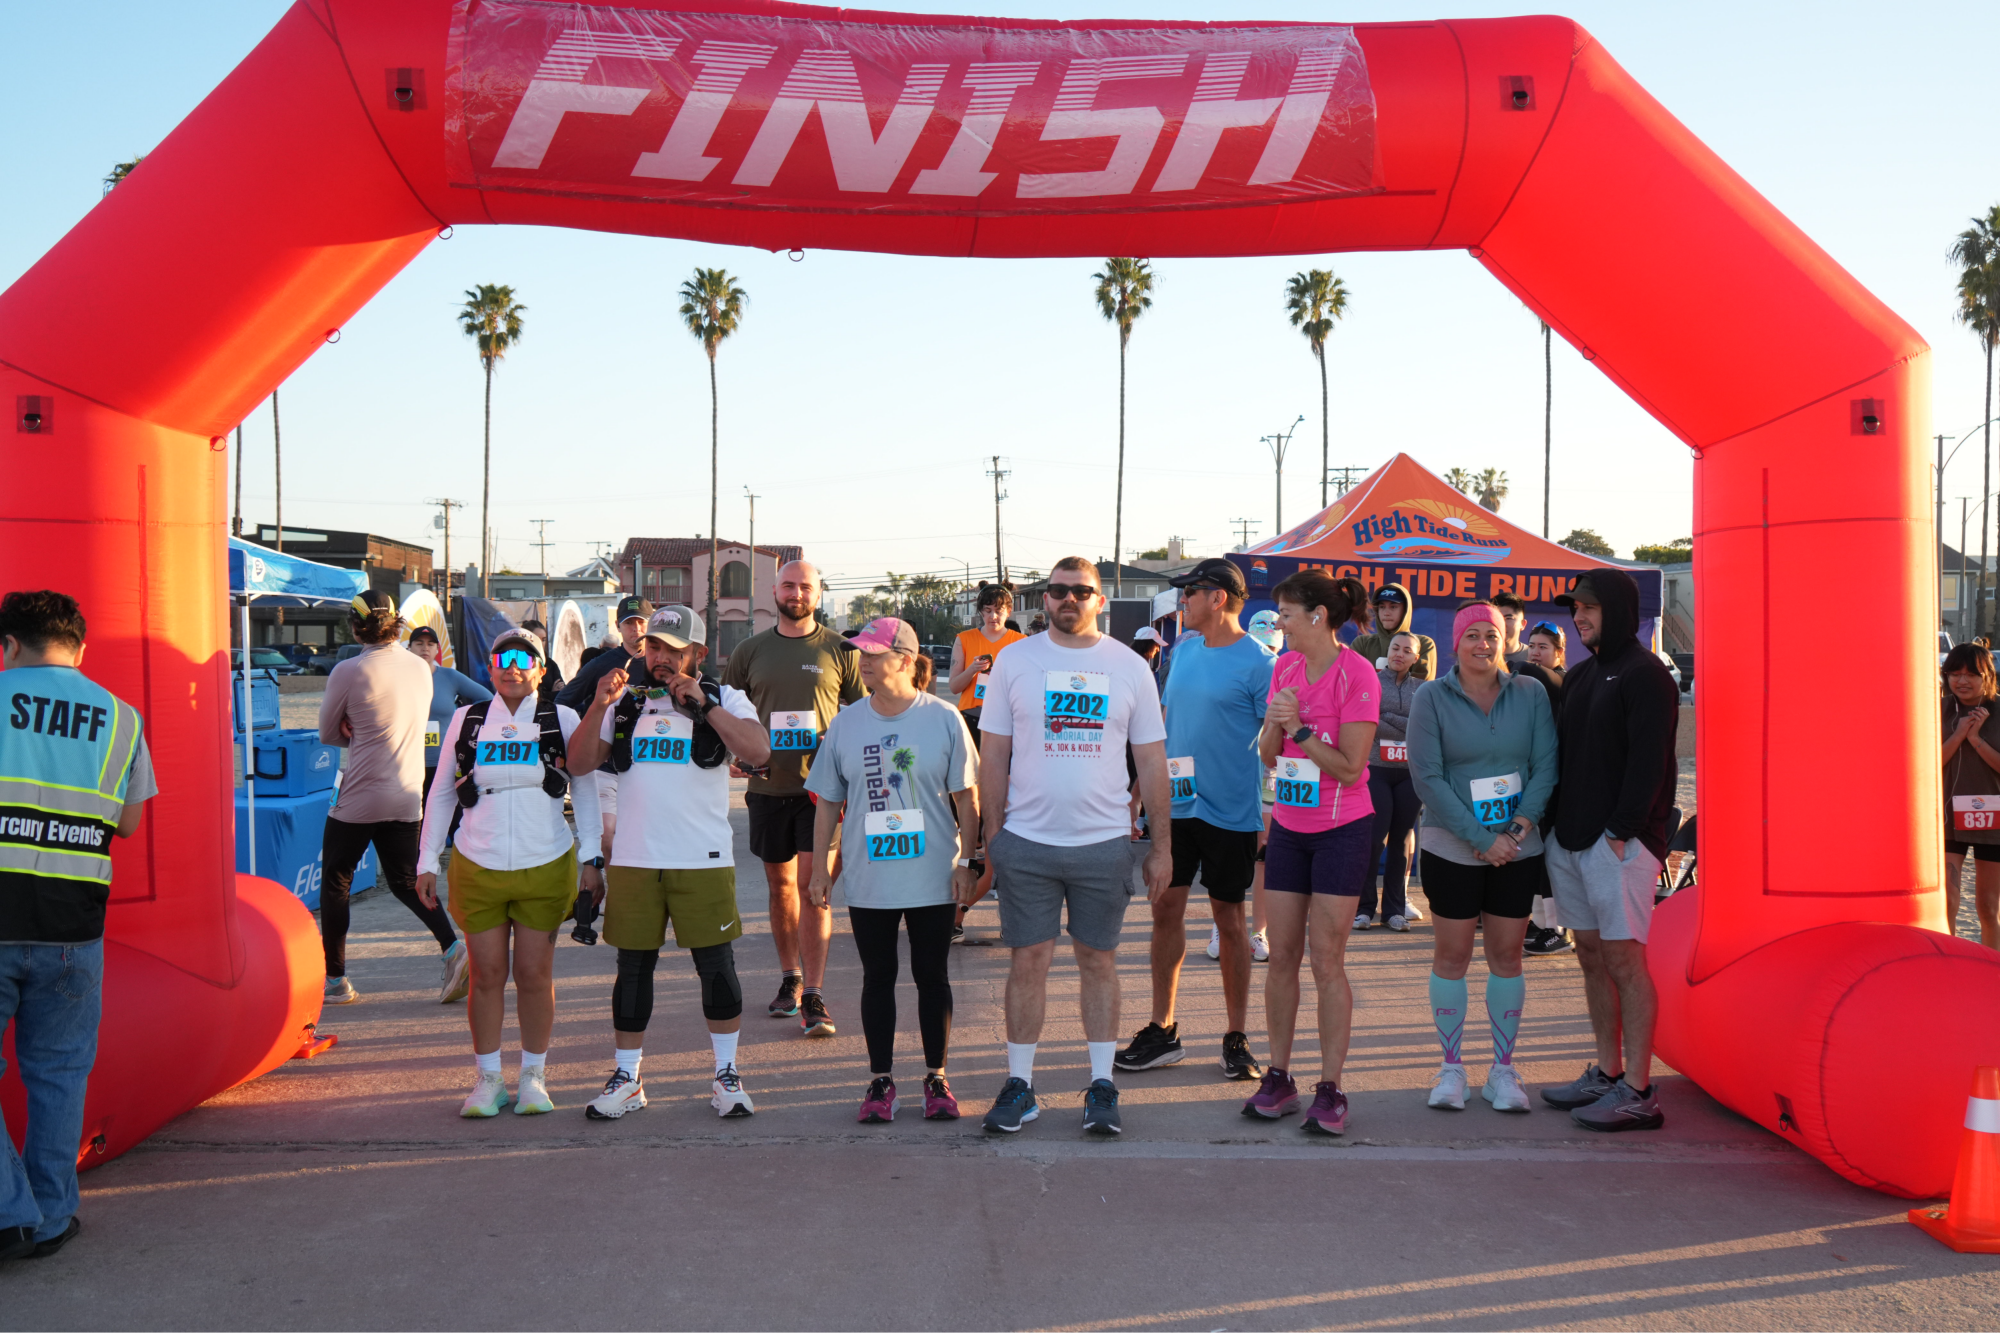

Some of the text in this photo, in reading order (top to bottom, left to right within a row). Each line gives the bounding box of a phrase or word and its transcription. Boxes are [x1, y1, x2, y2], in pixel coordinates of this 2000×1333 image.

[491, 28, 1350, 199] FINISH
[1352, 510, 1507, 547] High Tide Runs
[1395, 568, 1477, 599] TIDE
[1051, 692, 1104, 716] 2202
[10, 693, 107, 742] STAFF
[774, 730, 812, 747] 2316
[1044, 731, 1103, 742] MEMORIAL DAY
[1045, 743, 1102, 752] 5K, 10K & KIDS 1K
[484, 742, 532, 762] 2197
[637, 739, 685, 760] 2198
[1278, 780, 1313, 804] 2312
[0, 816, 105, 846] rcury Events
[1964, 812, 1994, 828] 837
[872, 833, 920, 858] 2201
